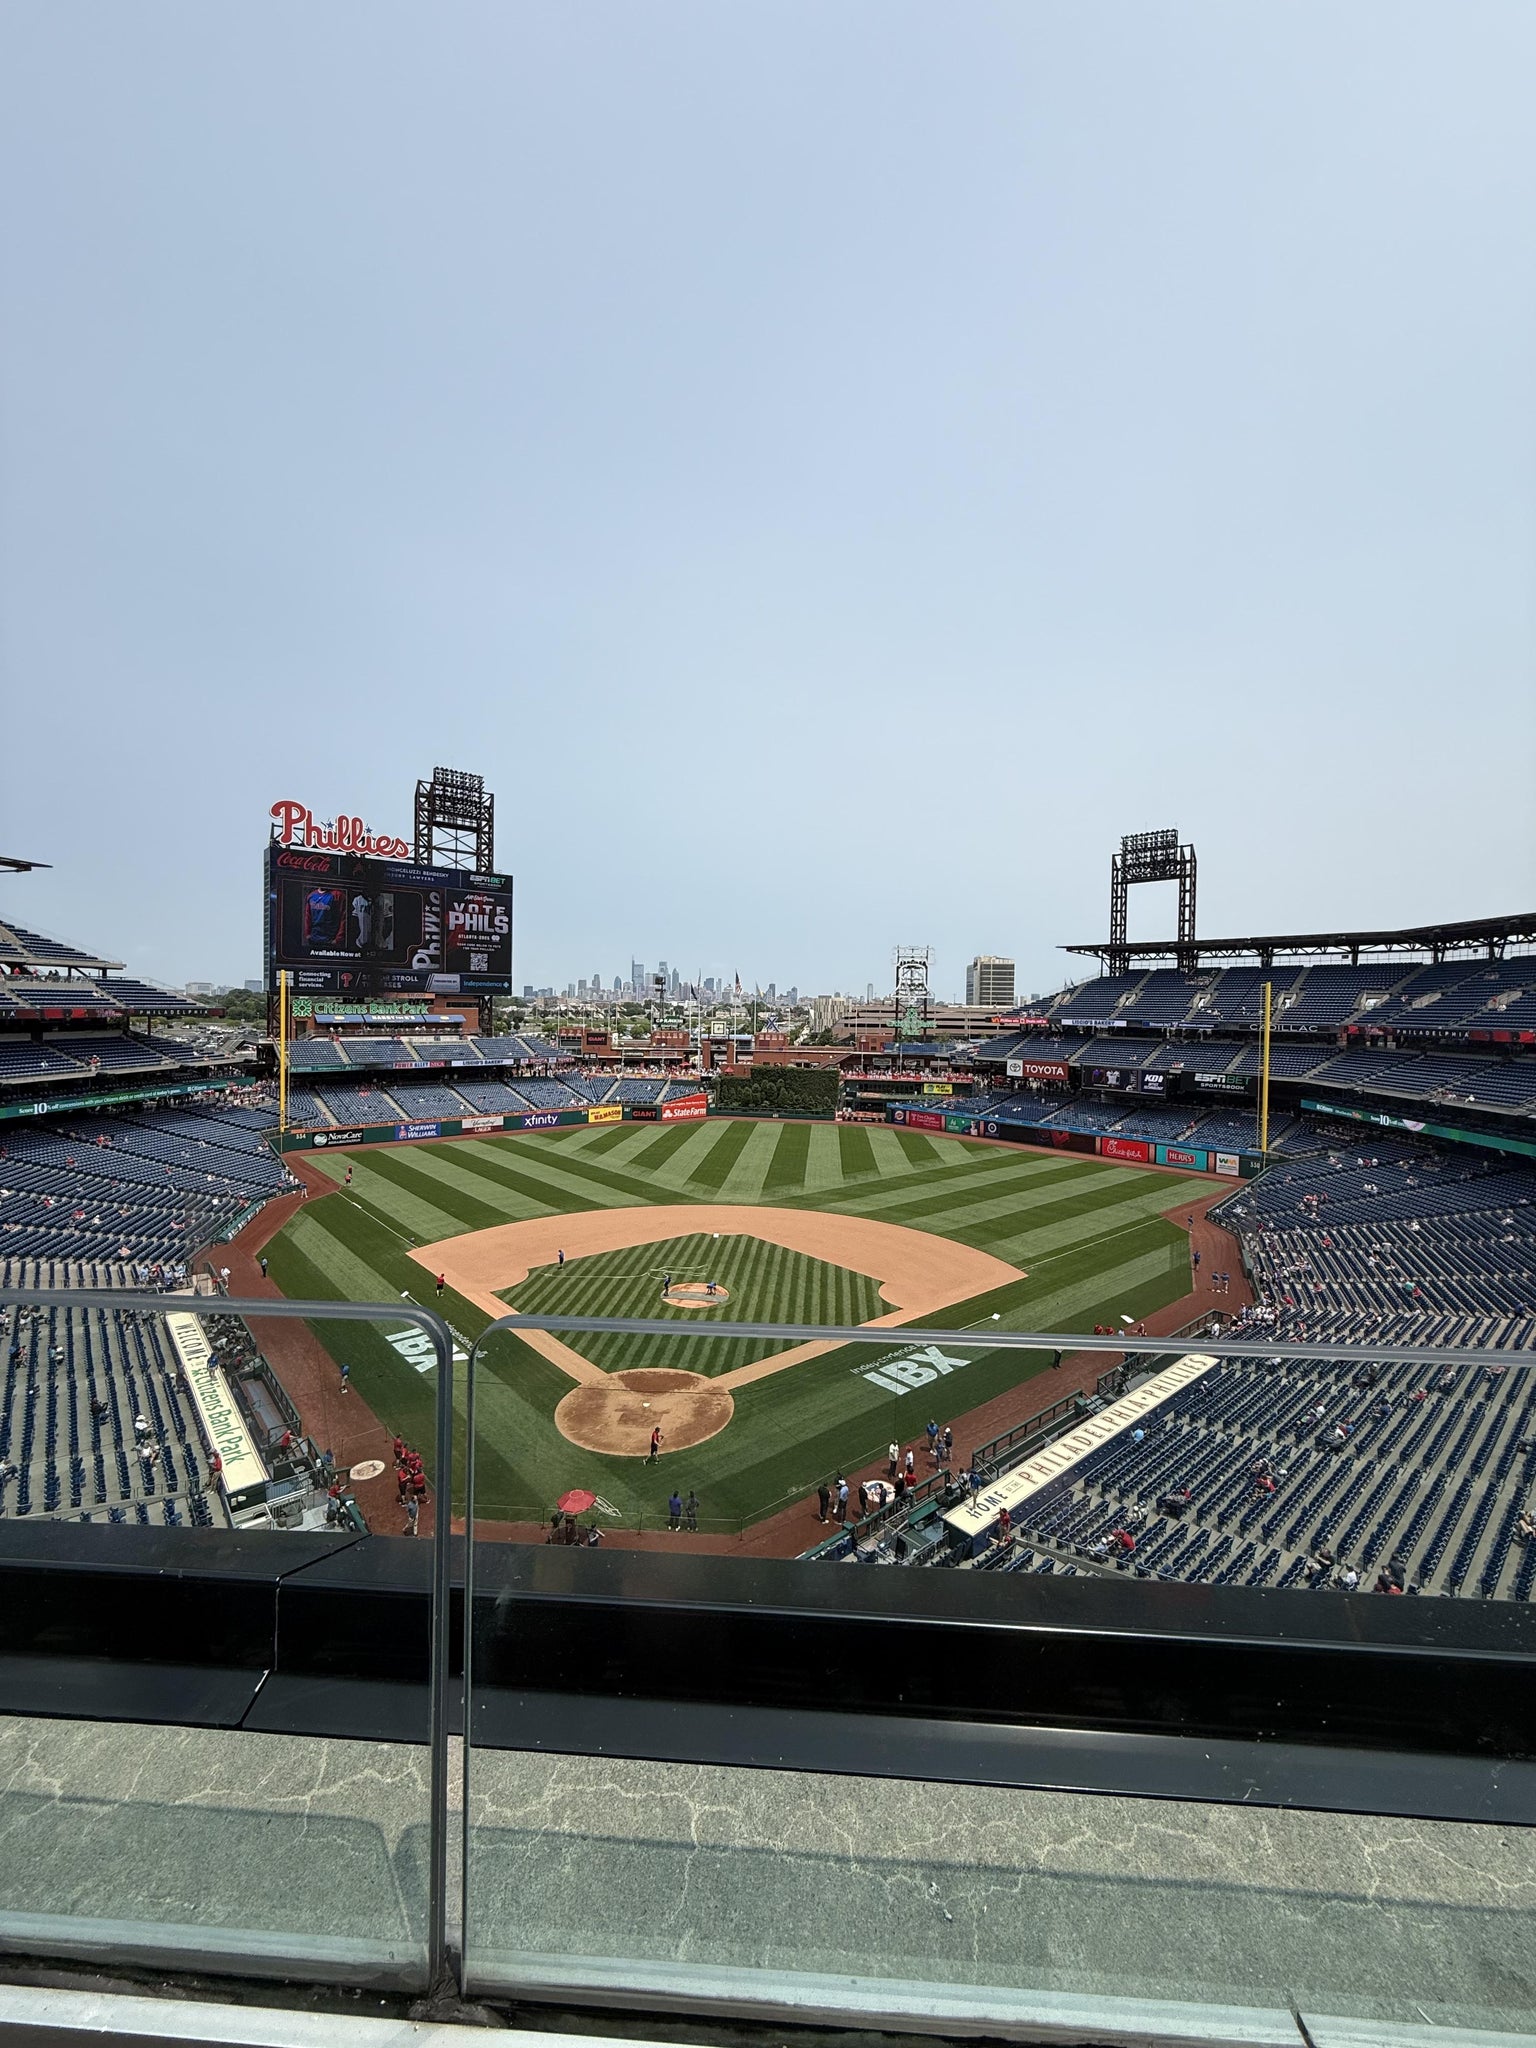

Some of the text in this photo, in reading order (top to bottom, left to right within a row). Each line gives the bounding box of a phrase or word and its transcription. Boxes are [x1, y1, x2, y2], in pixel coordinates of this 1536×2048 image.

[269, 800, 409, 858] Phillies
[453, 902, 506, 915] VOTE
[448, 911, 509, 934] PHILS
[310, 949, 340, 957] Available
[298, 971, 332, 979] Connecting
[463, 980, 502, 988] Independence
[314, 1002, 429, 1015] Citizens Bank Park
[1396, 1029, 1469, 1038] PHILADELPHIA
[1025, 1064, 1064, 1076] TOYOTA
[1194, 1073, 1252, 1085] ESPN BET
[1200, 1082, 1246, 1091] SPORTSBOOK
[673, 1107, 706, 1117] State Farm
[523, 1113, 558, 1128] xfinity
[407, 1124, 437, 1132] SHERWIN
[327, 1131, 363, 1141] NovaCare
[175, 1322, 208, 1362] WELCOME
[850, 1344, 917, 1375] Independence
[862, 1345, 973, 1395] IBX
[195, 1374, 250, 1466] Citizens Bank Park
[965, 1490, 1009, 1519] HOME
[1016, 1395, 1147, 1485] PHILADELPHIA
[1142, 1355, 1208, 1400] PHILLIES
